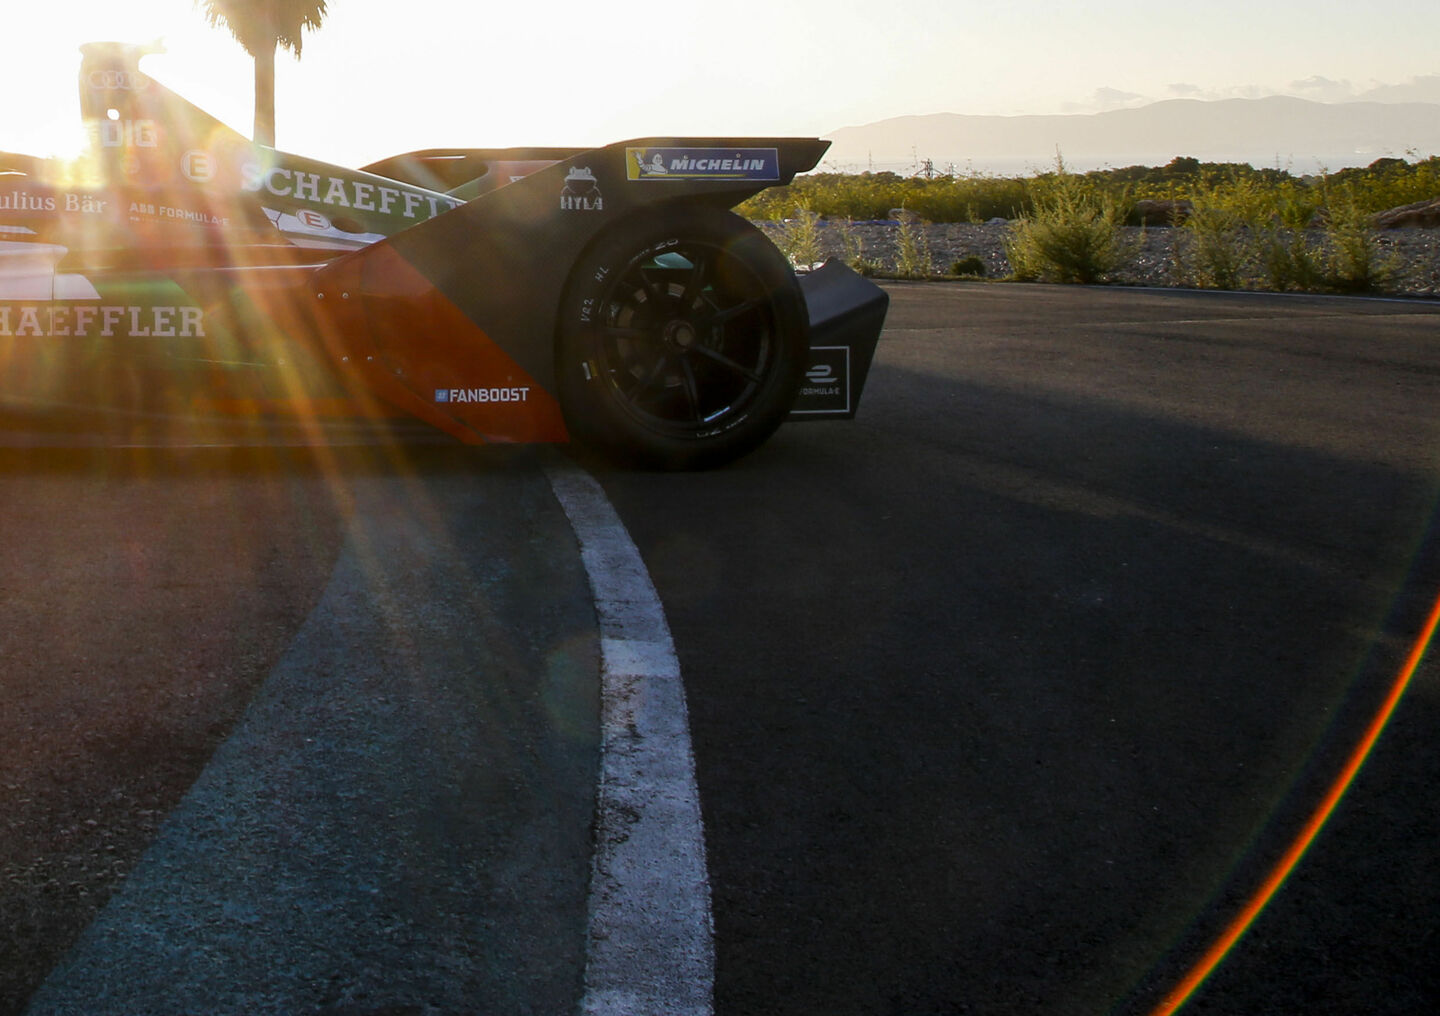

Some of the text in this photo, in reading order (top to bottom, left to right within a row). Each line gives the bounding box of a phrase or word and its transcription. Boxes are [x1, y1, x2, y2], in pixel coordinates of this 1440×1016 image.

[670, 157, 765, 172] MICHELIN
[65, 190, 109, 214] Bär
[561, 195, 603, 210] HYLA
